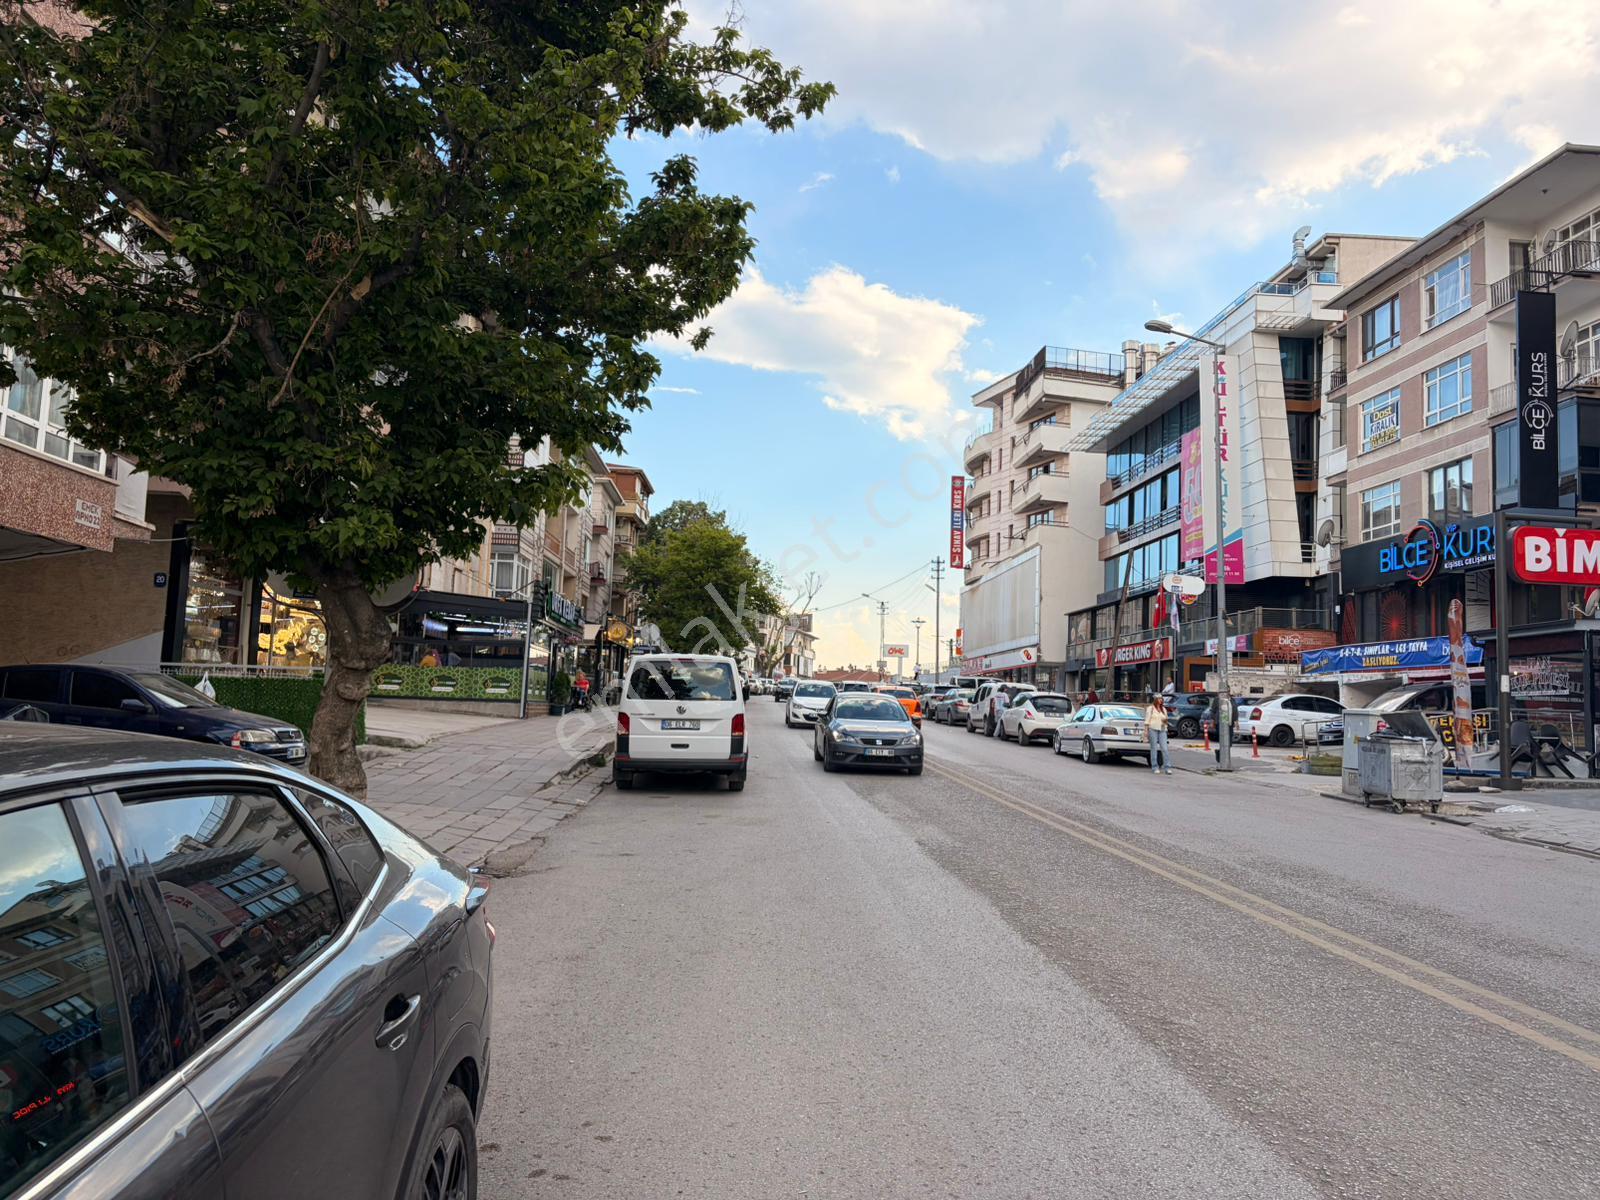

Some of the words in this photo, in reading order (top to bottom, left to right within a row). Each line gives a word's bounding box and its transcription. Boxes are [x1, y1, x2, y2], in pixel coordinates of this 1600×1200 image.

[1531, 352, 1544, 397] KURS
[1524, 528, 1600, 574] BİM
[1134, 643, 1151, 660] KING
